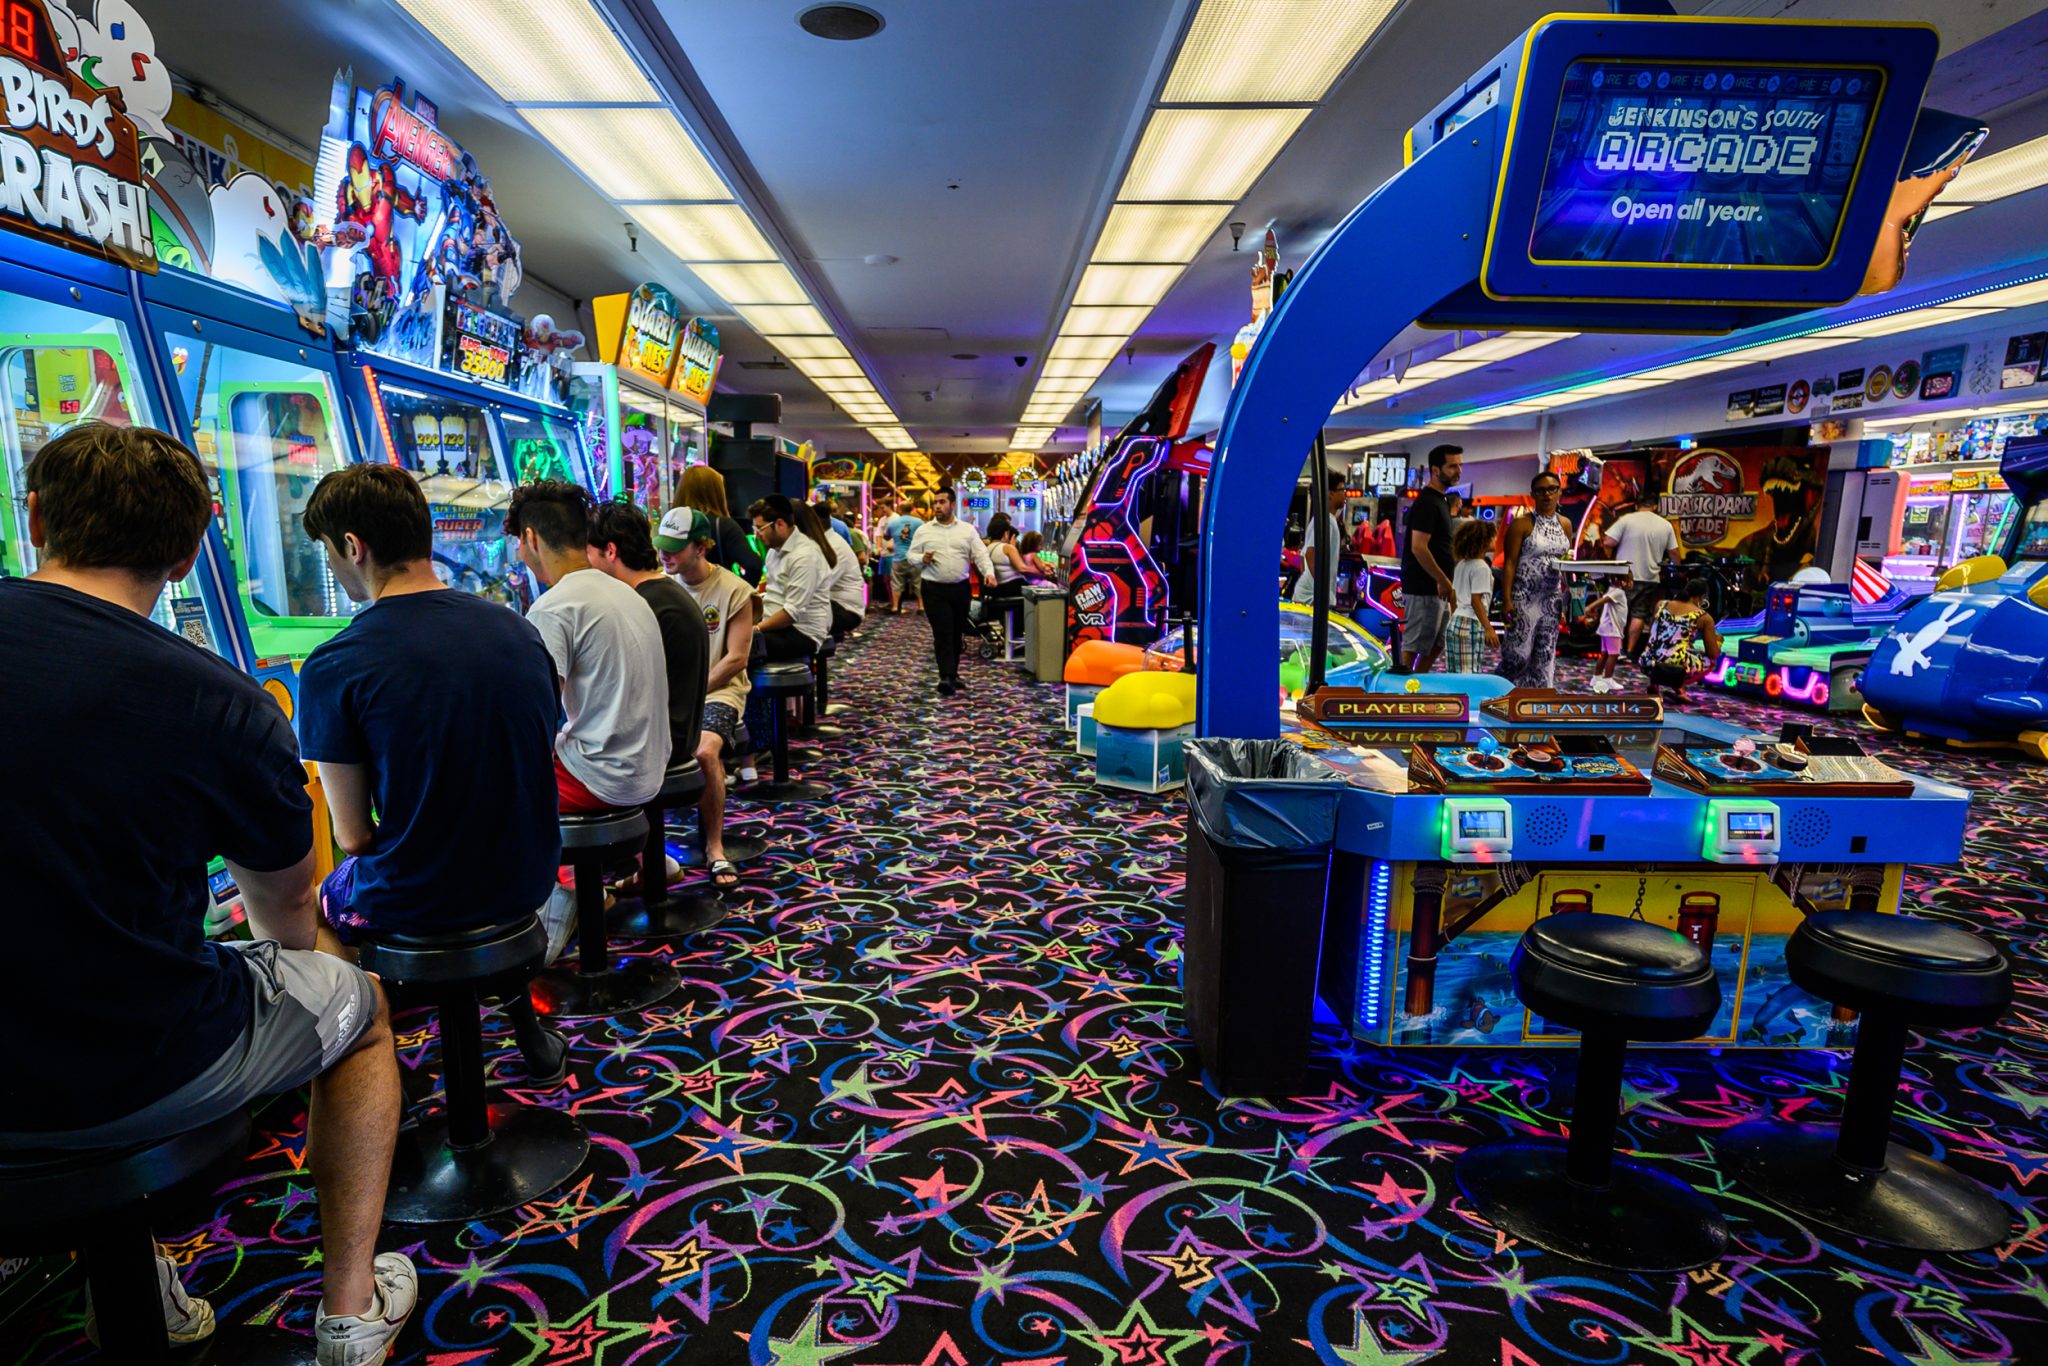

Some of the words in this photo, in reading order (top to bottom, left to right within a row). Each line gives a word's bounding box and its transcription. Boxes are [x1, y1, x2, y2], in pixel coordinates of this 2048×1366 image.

[0, 68, 115, 159] BIRDS
[1608, 102, 1758, 130] JENKINSON'S
[1762, 107, 1825, 131] SOUTH
[372, 80, 459, 182] AVENGER
[1596, 131, 1818, 175] ARCADE
[0, 131, 154, 258] RASH!
[1611, 196, 1673, 226] Open
[1677, 198, 1706, 221] all
[1708, 204, 1763, 227] year.
[417, 433, 440, 446] 200
[1370, 457, 1406, 469] WALKING
[1368, 468, 1406, 486] DEAD
[1660, 496, 1712, 516] JURASSIC
[1713, 494, 1752, 517] PARK
[434, 519, 483, 530] SUPER
[1680, 518, 1723, 534] ARCADE
[1075, 583, 1103, 604] RAW
[1078, 612, 1106, 625] VR
[1339, 703, 1427, 714] PLAYER
[1435, 703, 1447, 714] 3
[1532, 703, 1619, 714] PLAYER
[1628, 703, 1641, 714] 4
